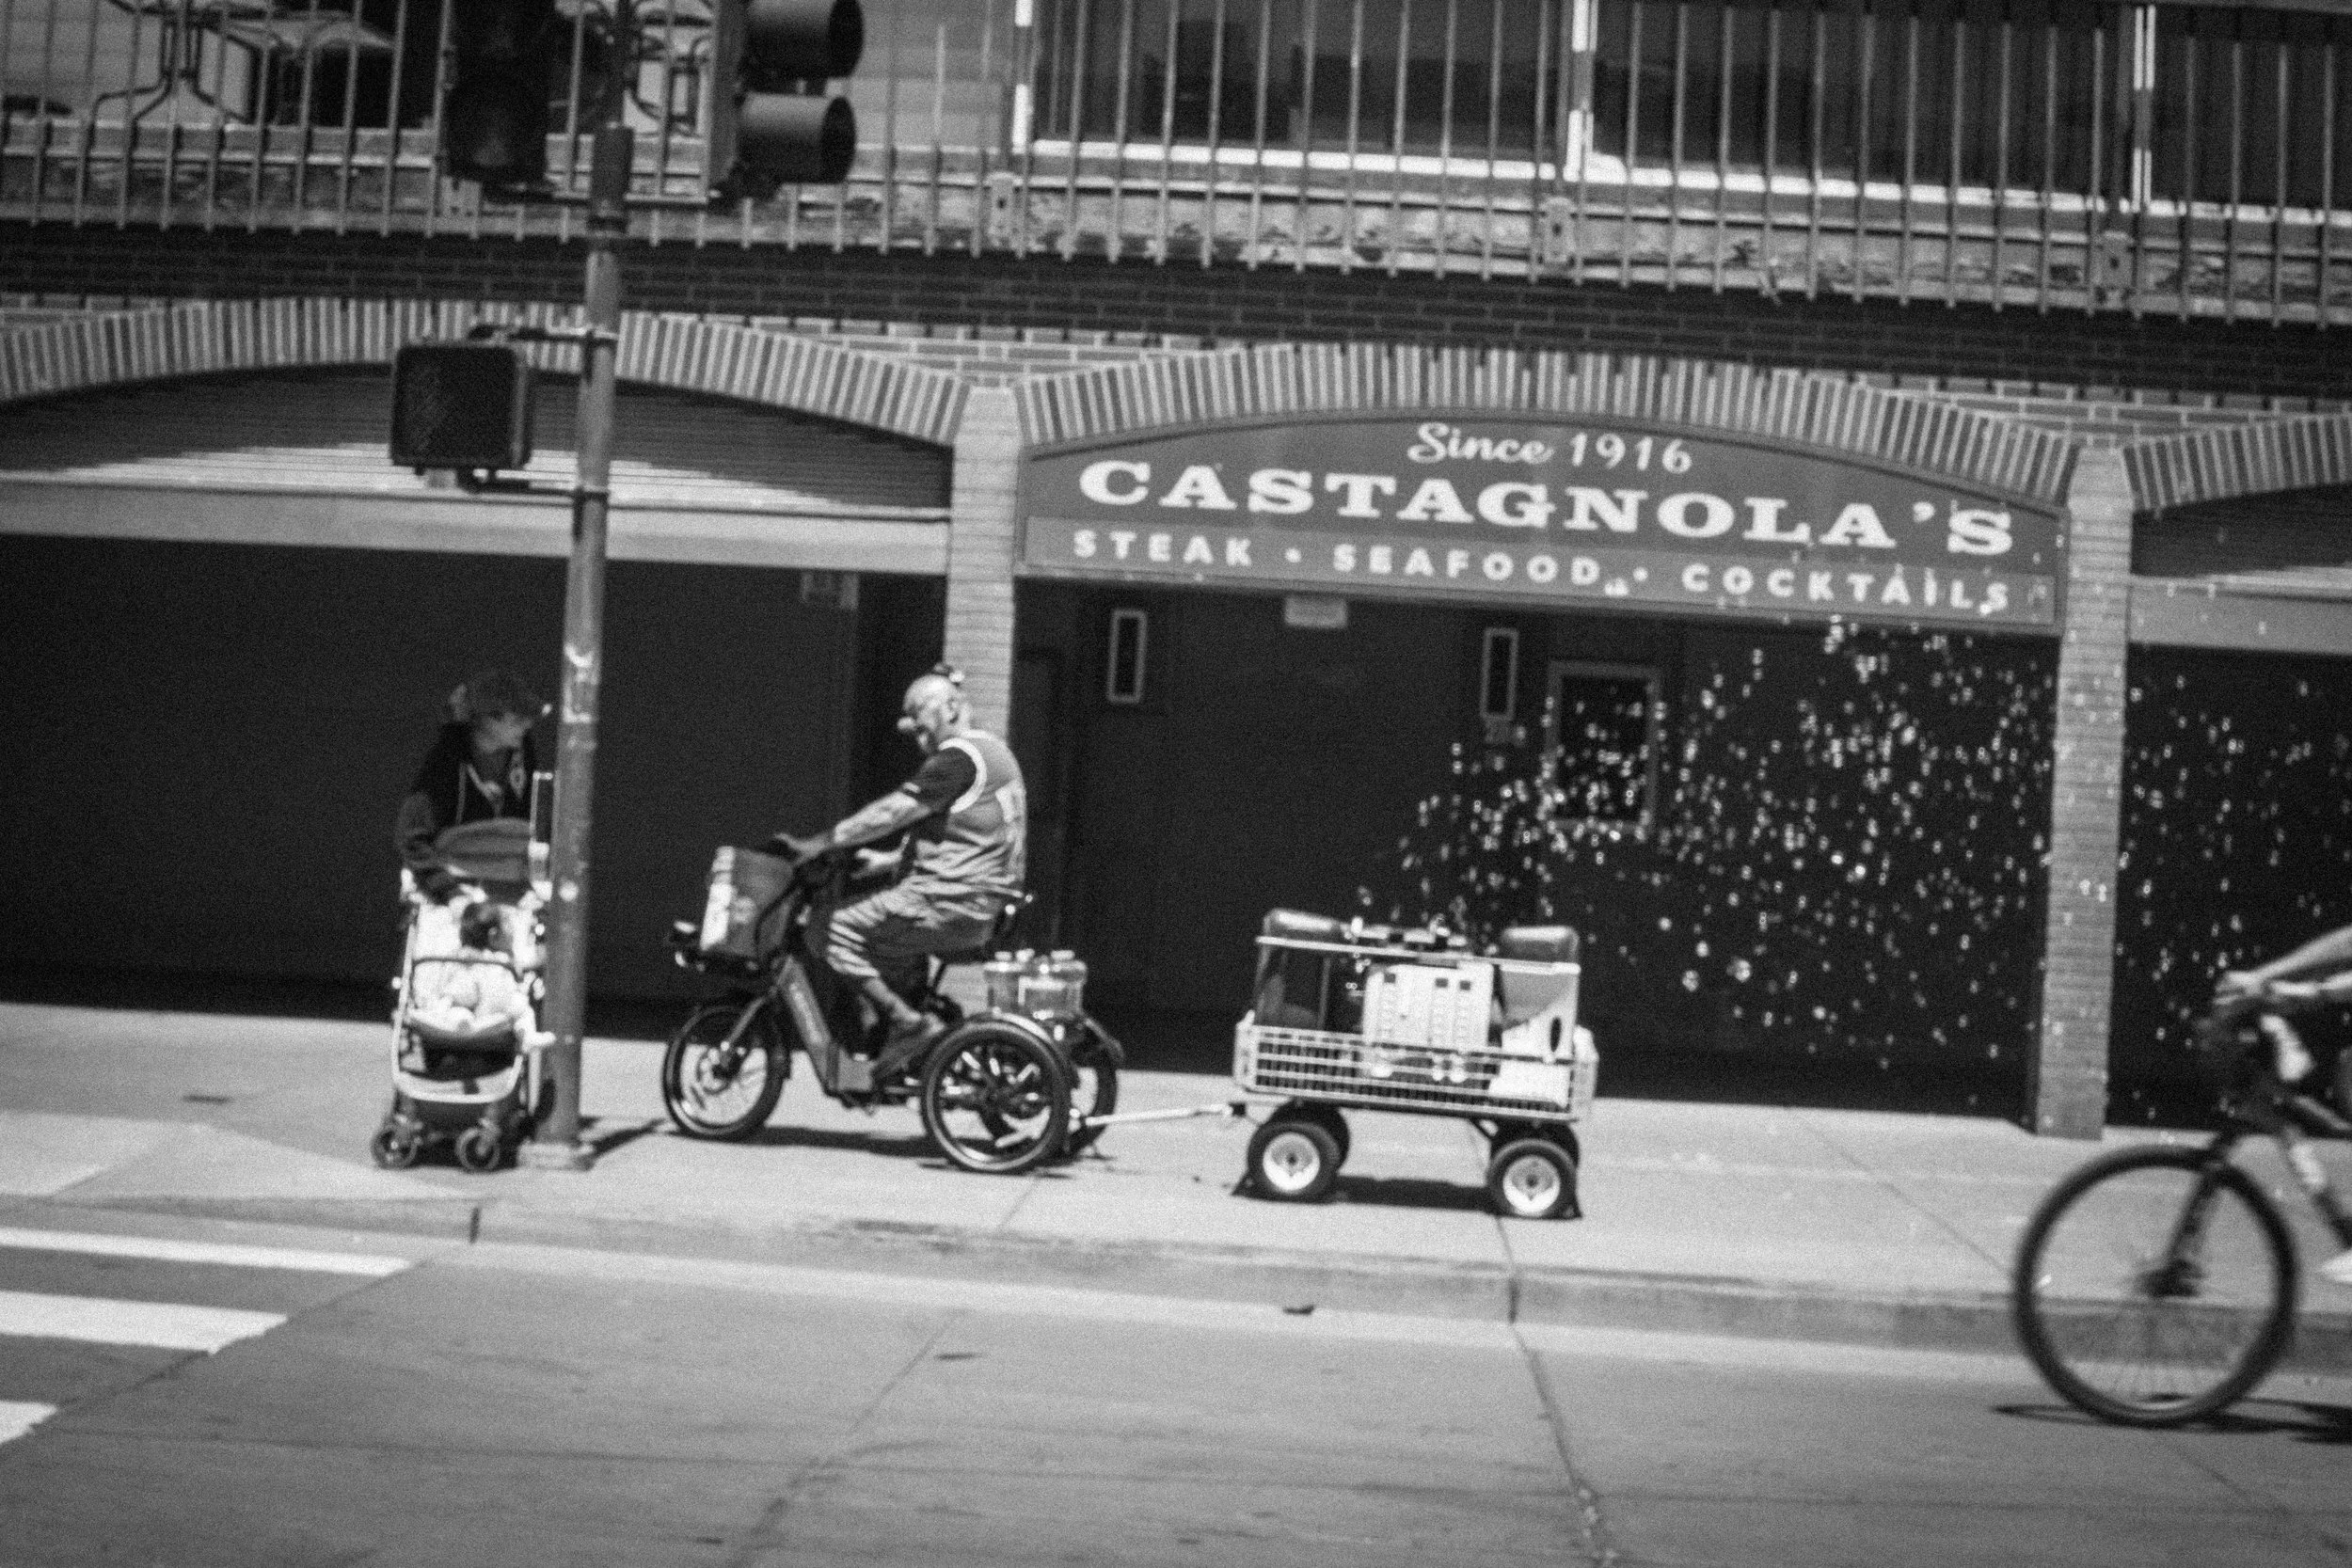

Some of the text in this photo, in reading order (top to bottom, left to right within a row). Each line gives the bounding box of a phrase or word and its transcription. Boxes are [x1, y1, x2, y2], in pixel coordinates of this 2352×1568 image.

[1406, 422, 1694, 474] Since 1916
[1078, 459, 2014, 557] CASTAGNOLA'S
[1073, 529, 2010, 616] STEAK SEAFOOD COCKTAILS
